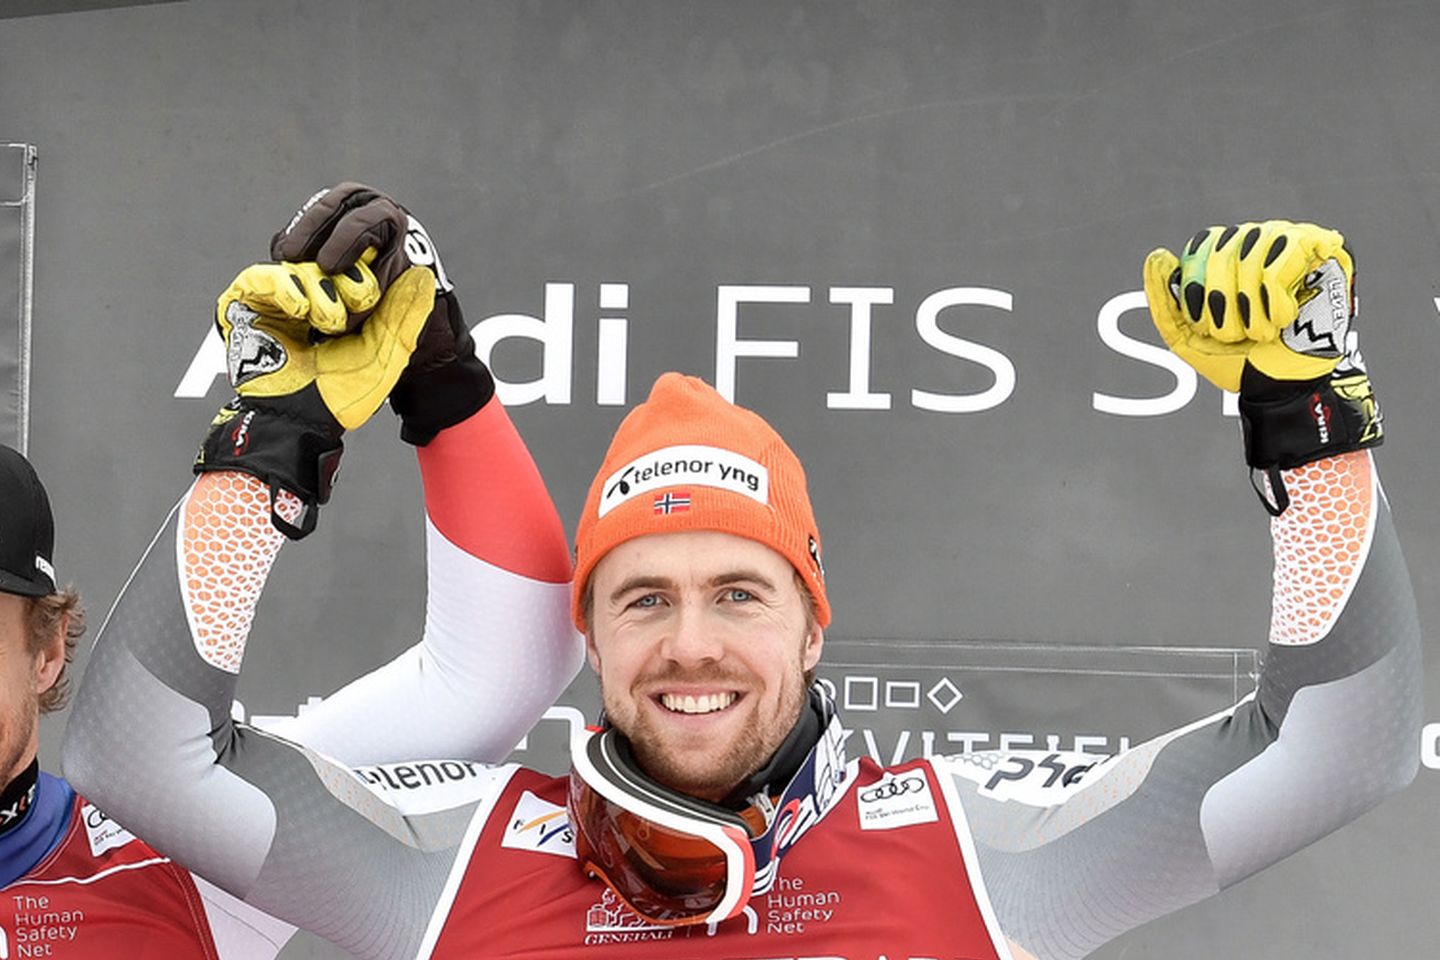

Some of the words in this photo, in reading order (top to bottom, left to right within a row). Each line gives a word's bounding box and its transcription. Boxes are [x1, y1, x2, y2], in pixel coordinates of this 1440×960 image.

[716, 285, 1017, 413] FIS
[633, 459, 714, 485] telenor
[719, 463, 760, 492] yng
[13, 895, 49, 909] The
[767, 891, 840, 909] Human
[15, 910, 84, 926] Human
[767, 908, 834, 924] Safety
[16, 925, 78, 942] Safety
[767, 922, 805, 935] Net
[17, 943, 53, 958] Net
